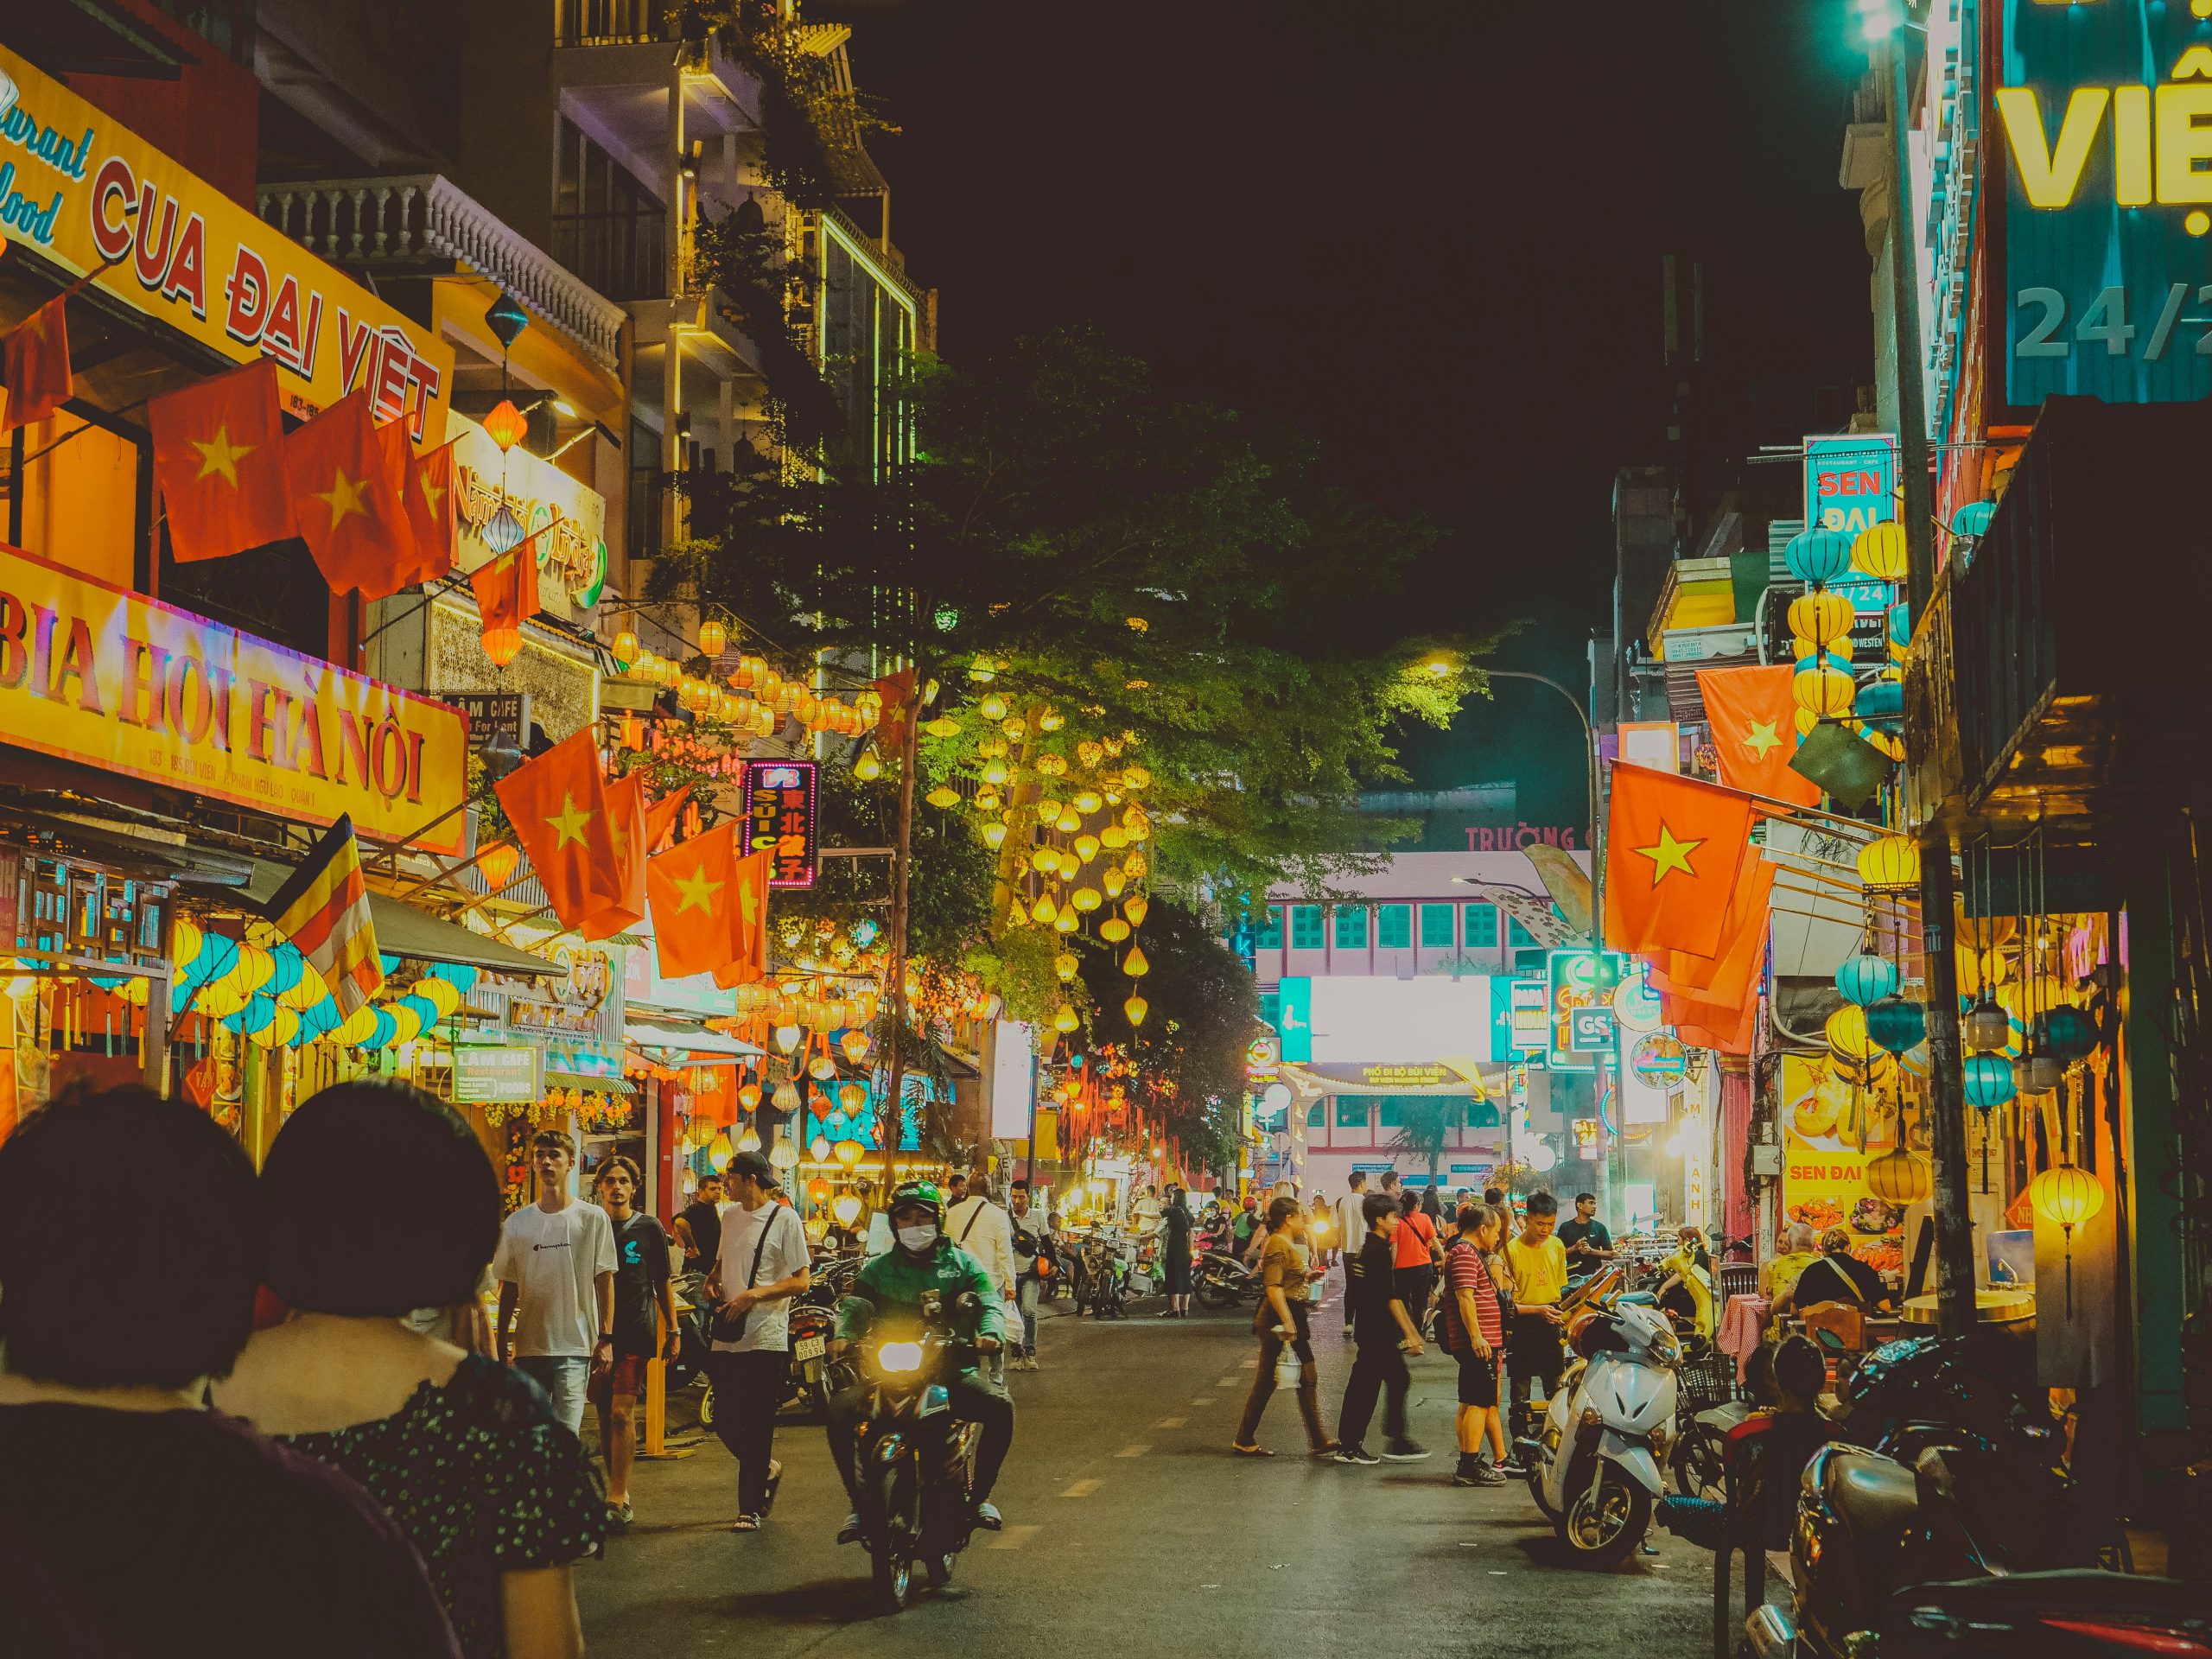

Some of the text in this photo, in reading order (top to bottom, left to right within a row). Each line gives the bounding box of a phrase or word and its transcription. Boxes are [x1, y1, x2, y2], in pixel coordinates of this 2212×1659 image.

[91, 156, 207, 322] CUA
[1818, 471, 1880, 496] SEN
[0, 590, 105, 717] BIA
[245, 670, 329, 782] HÀ
[334, 702, 426, 813] NỘI
[447, 696, 484, 717] ÂM
[457, 1051, 531, 1066] LÂM CAFÉ
[467, 1066, 521, 1076] Restaurant
[499, 1082, 531, 1094] FOODS
[1789, 1165, 1862, 1184] SEN ĐẠI
